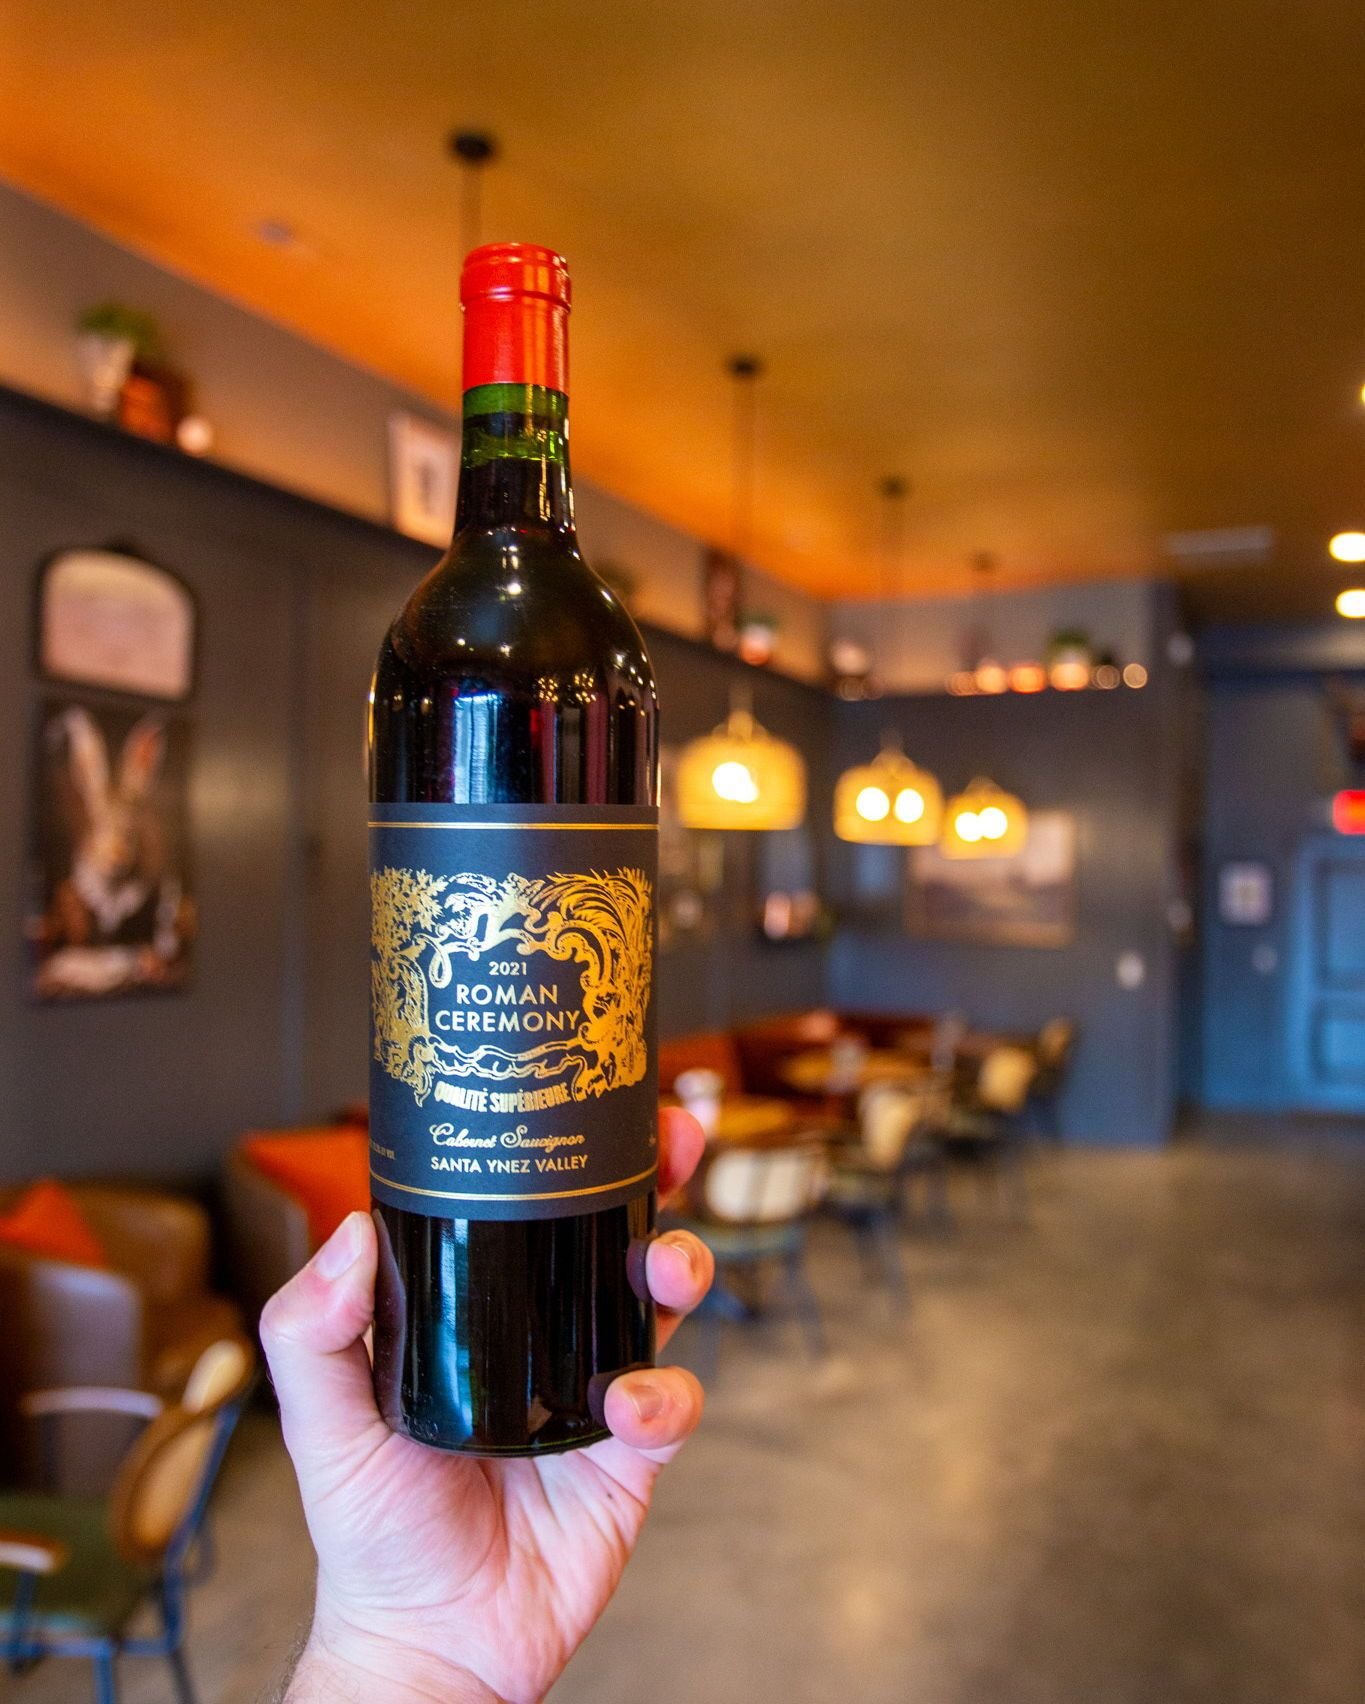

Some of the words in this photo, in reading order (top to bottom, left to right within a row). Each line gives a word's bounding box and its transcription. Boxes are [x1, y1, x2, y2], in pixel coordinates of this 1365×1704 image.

[488, 961, 527, 976] 2021
[456, 984, 558, 1005] ROMAN
[435, 1010, 580, 1032] CEREMONY
[434, 1080, 488, 1112] QUALITÉ
[489, 1082, 571, 1113] SUPÉRIEURE
[429, 1122, 497, 1148] Cabernet
[500, 1124, 585, 1153] Sauvignon
[431, 1156, 482, 1173] SANTA
[486, 1159, 530, 1174] YNEZ
[535, 1154, 588, 1174] VALLEY
